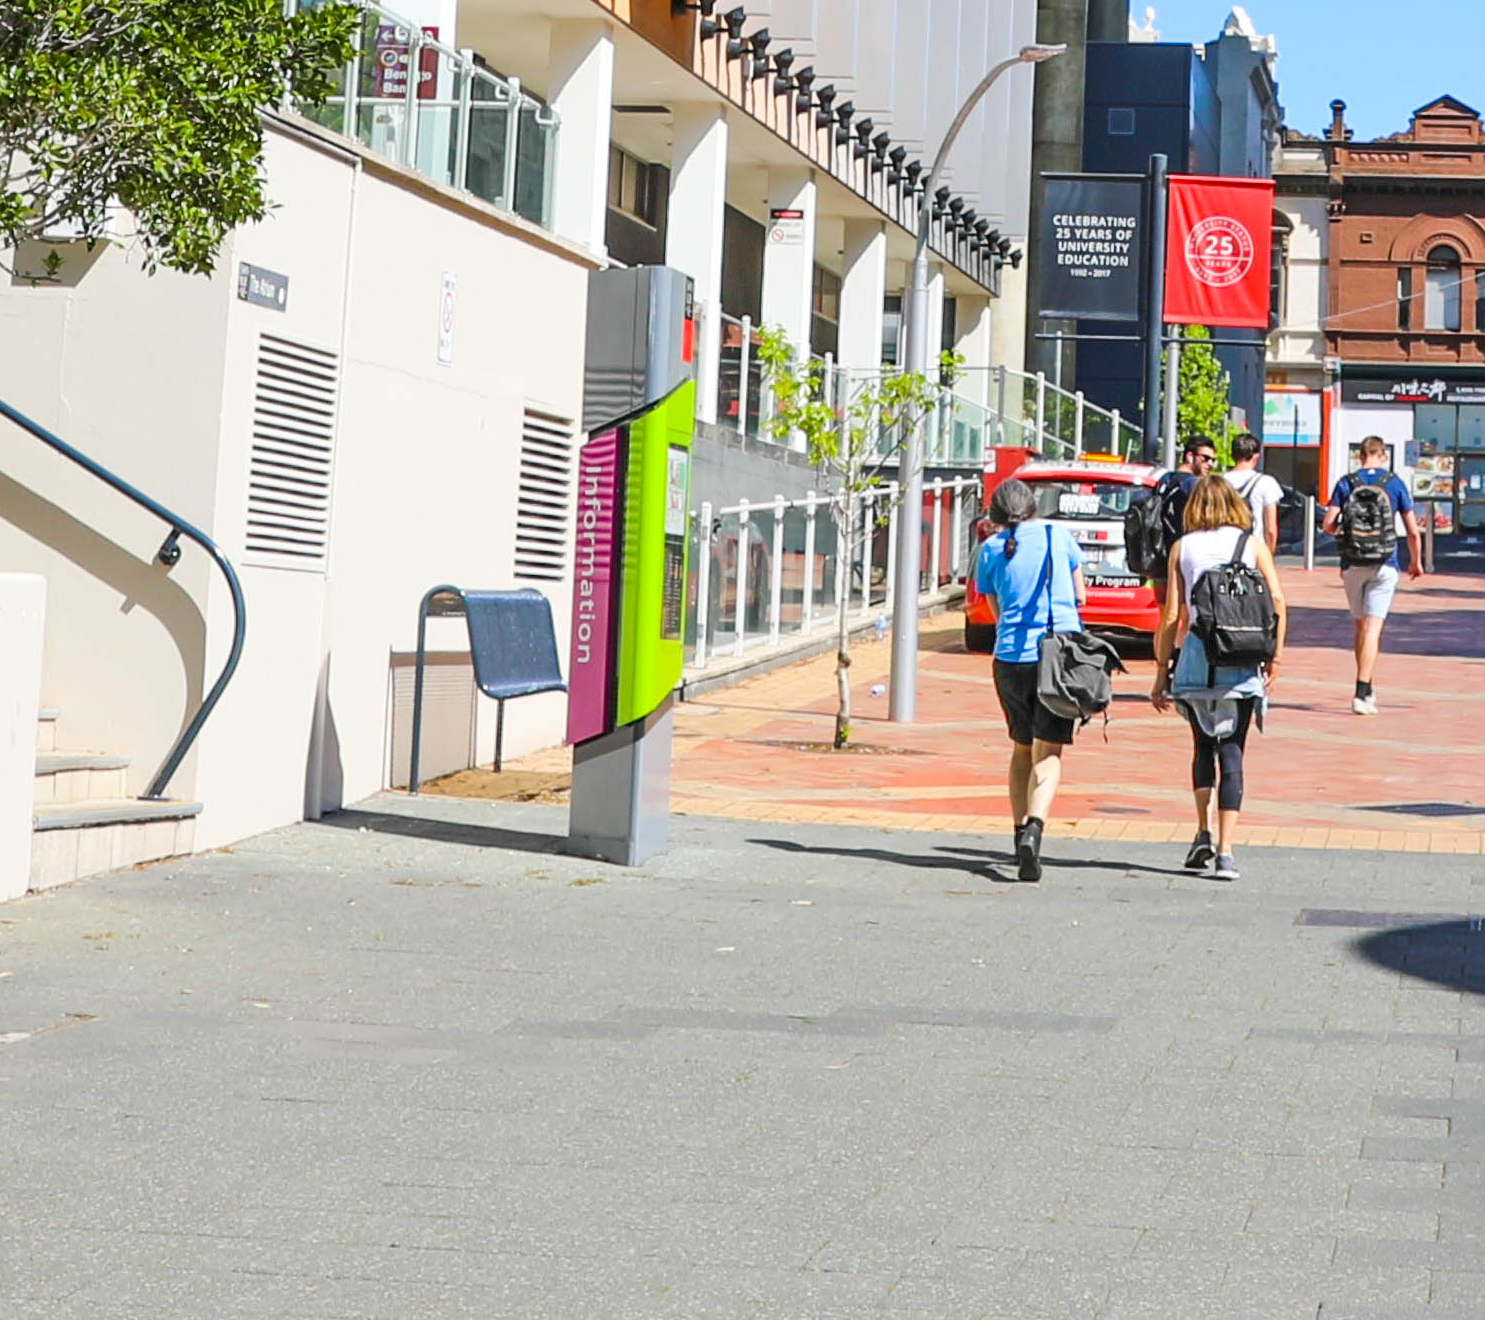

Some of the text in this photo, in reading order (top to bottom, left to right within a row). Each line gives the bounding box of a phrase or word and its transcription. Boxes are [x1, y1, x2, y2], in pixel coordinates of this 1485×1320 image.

[1053, 214, 1136, 229] CELEBRATING
[1056, 228, 1133, 241] 25 YEARS OF
[1058, 241, 1130, 254] UNIVERSITY
[1204, 234, 1234, 256] 25
[1057, 253, 1129, 267] EDUCATION
[576, 465, 602, 664] Information
[1095, 576, 1141, 588] Program
